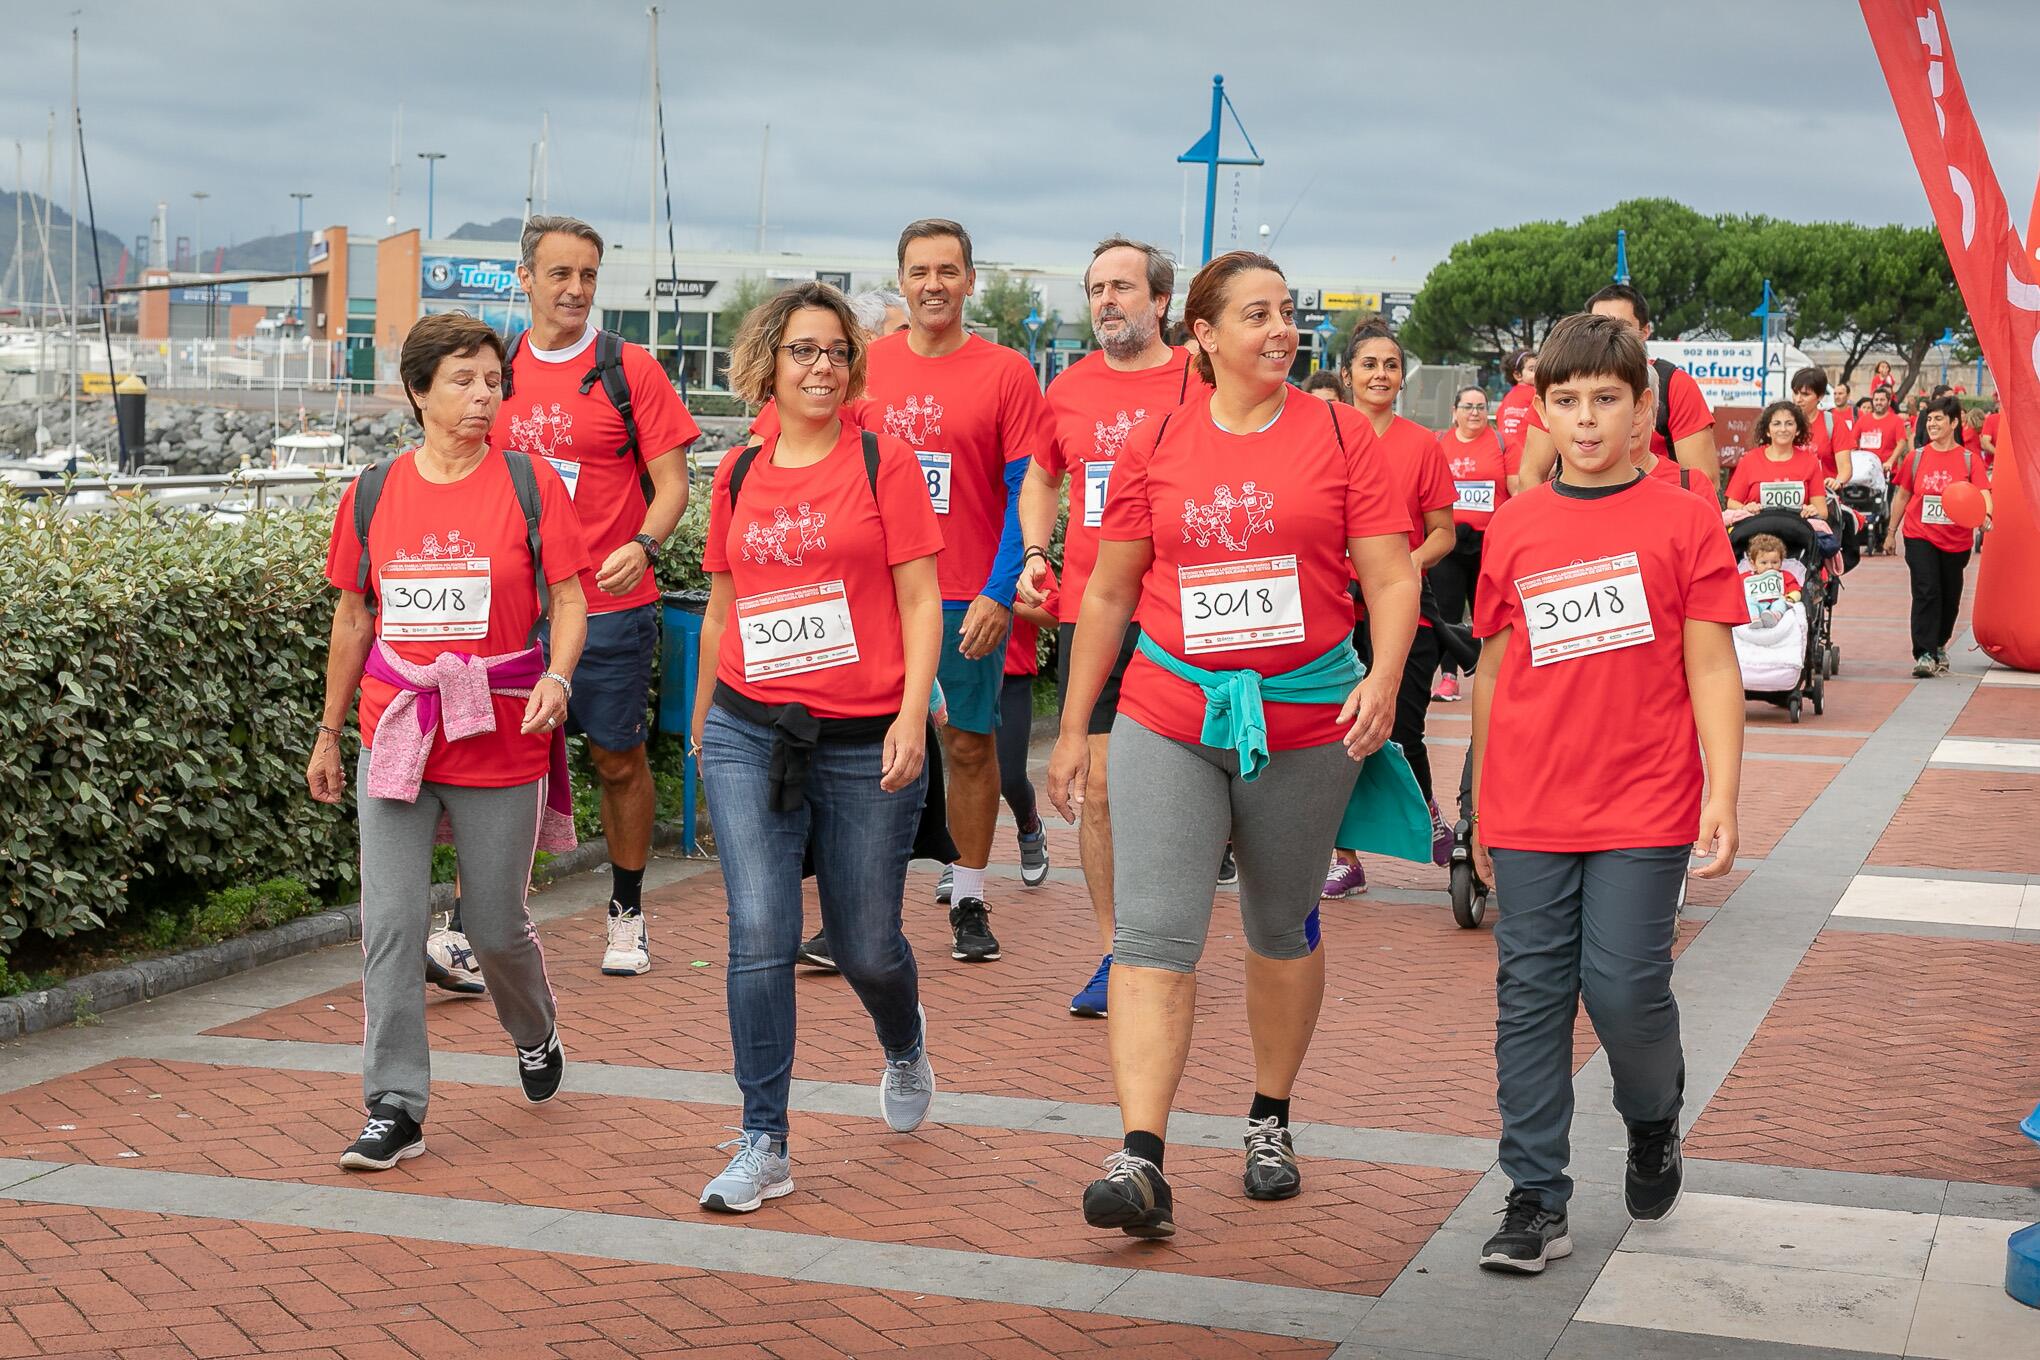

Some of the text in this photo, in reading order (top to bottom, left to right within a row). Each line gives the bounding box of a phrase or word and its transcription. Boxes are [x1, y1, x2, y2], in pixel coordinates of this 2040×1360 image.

[460, 264, 521, 293] Tarp
[1683, 348, 1703, 357] 902
[1769, 353, 1781, 366] A
[1766, 490, 1801, 506] 2060
[1927, 503, 1947, 518] 20
[394, 587, 466, 612] 3018
[1193, 588, 1273, 620] 3018
[1536, 585, 1625, 630] 3018
[752, 616, 825, 645] 3018
